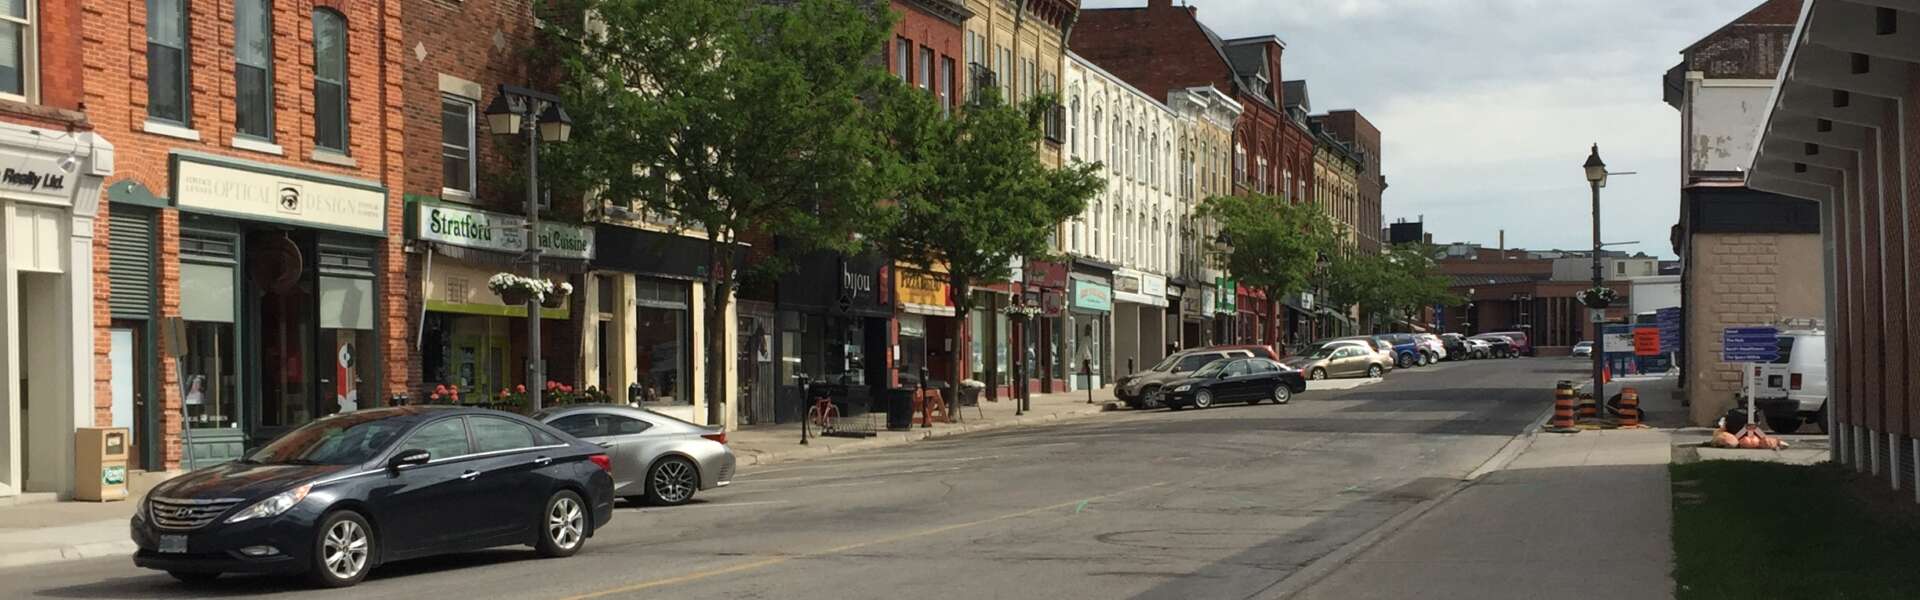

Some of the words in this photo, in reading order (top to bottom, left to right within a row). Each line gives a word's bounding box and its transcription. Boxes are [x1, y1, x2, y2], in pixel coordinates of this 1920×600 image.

[2, 167, 42, 190] Realty
[214, 179, 271, 204] OPTICAL
[306, 192, 356, 215] DESIGN
[430, 208, 492, 241] Stratford
[553, 231, 587, 252] Cuisine
[844, 261, 870, 298] bijou
